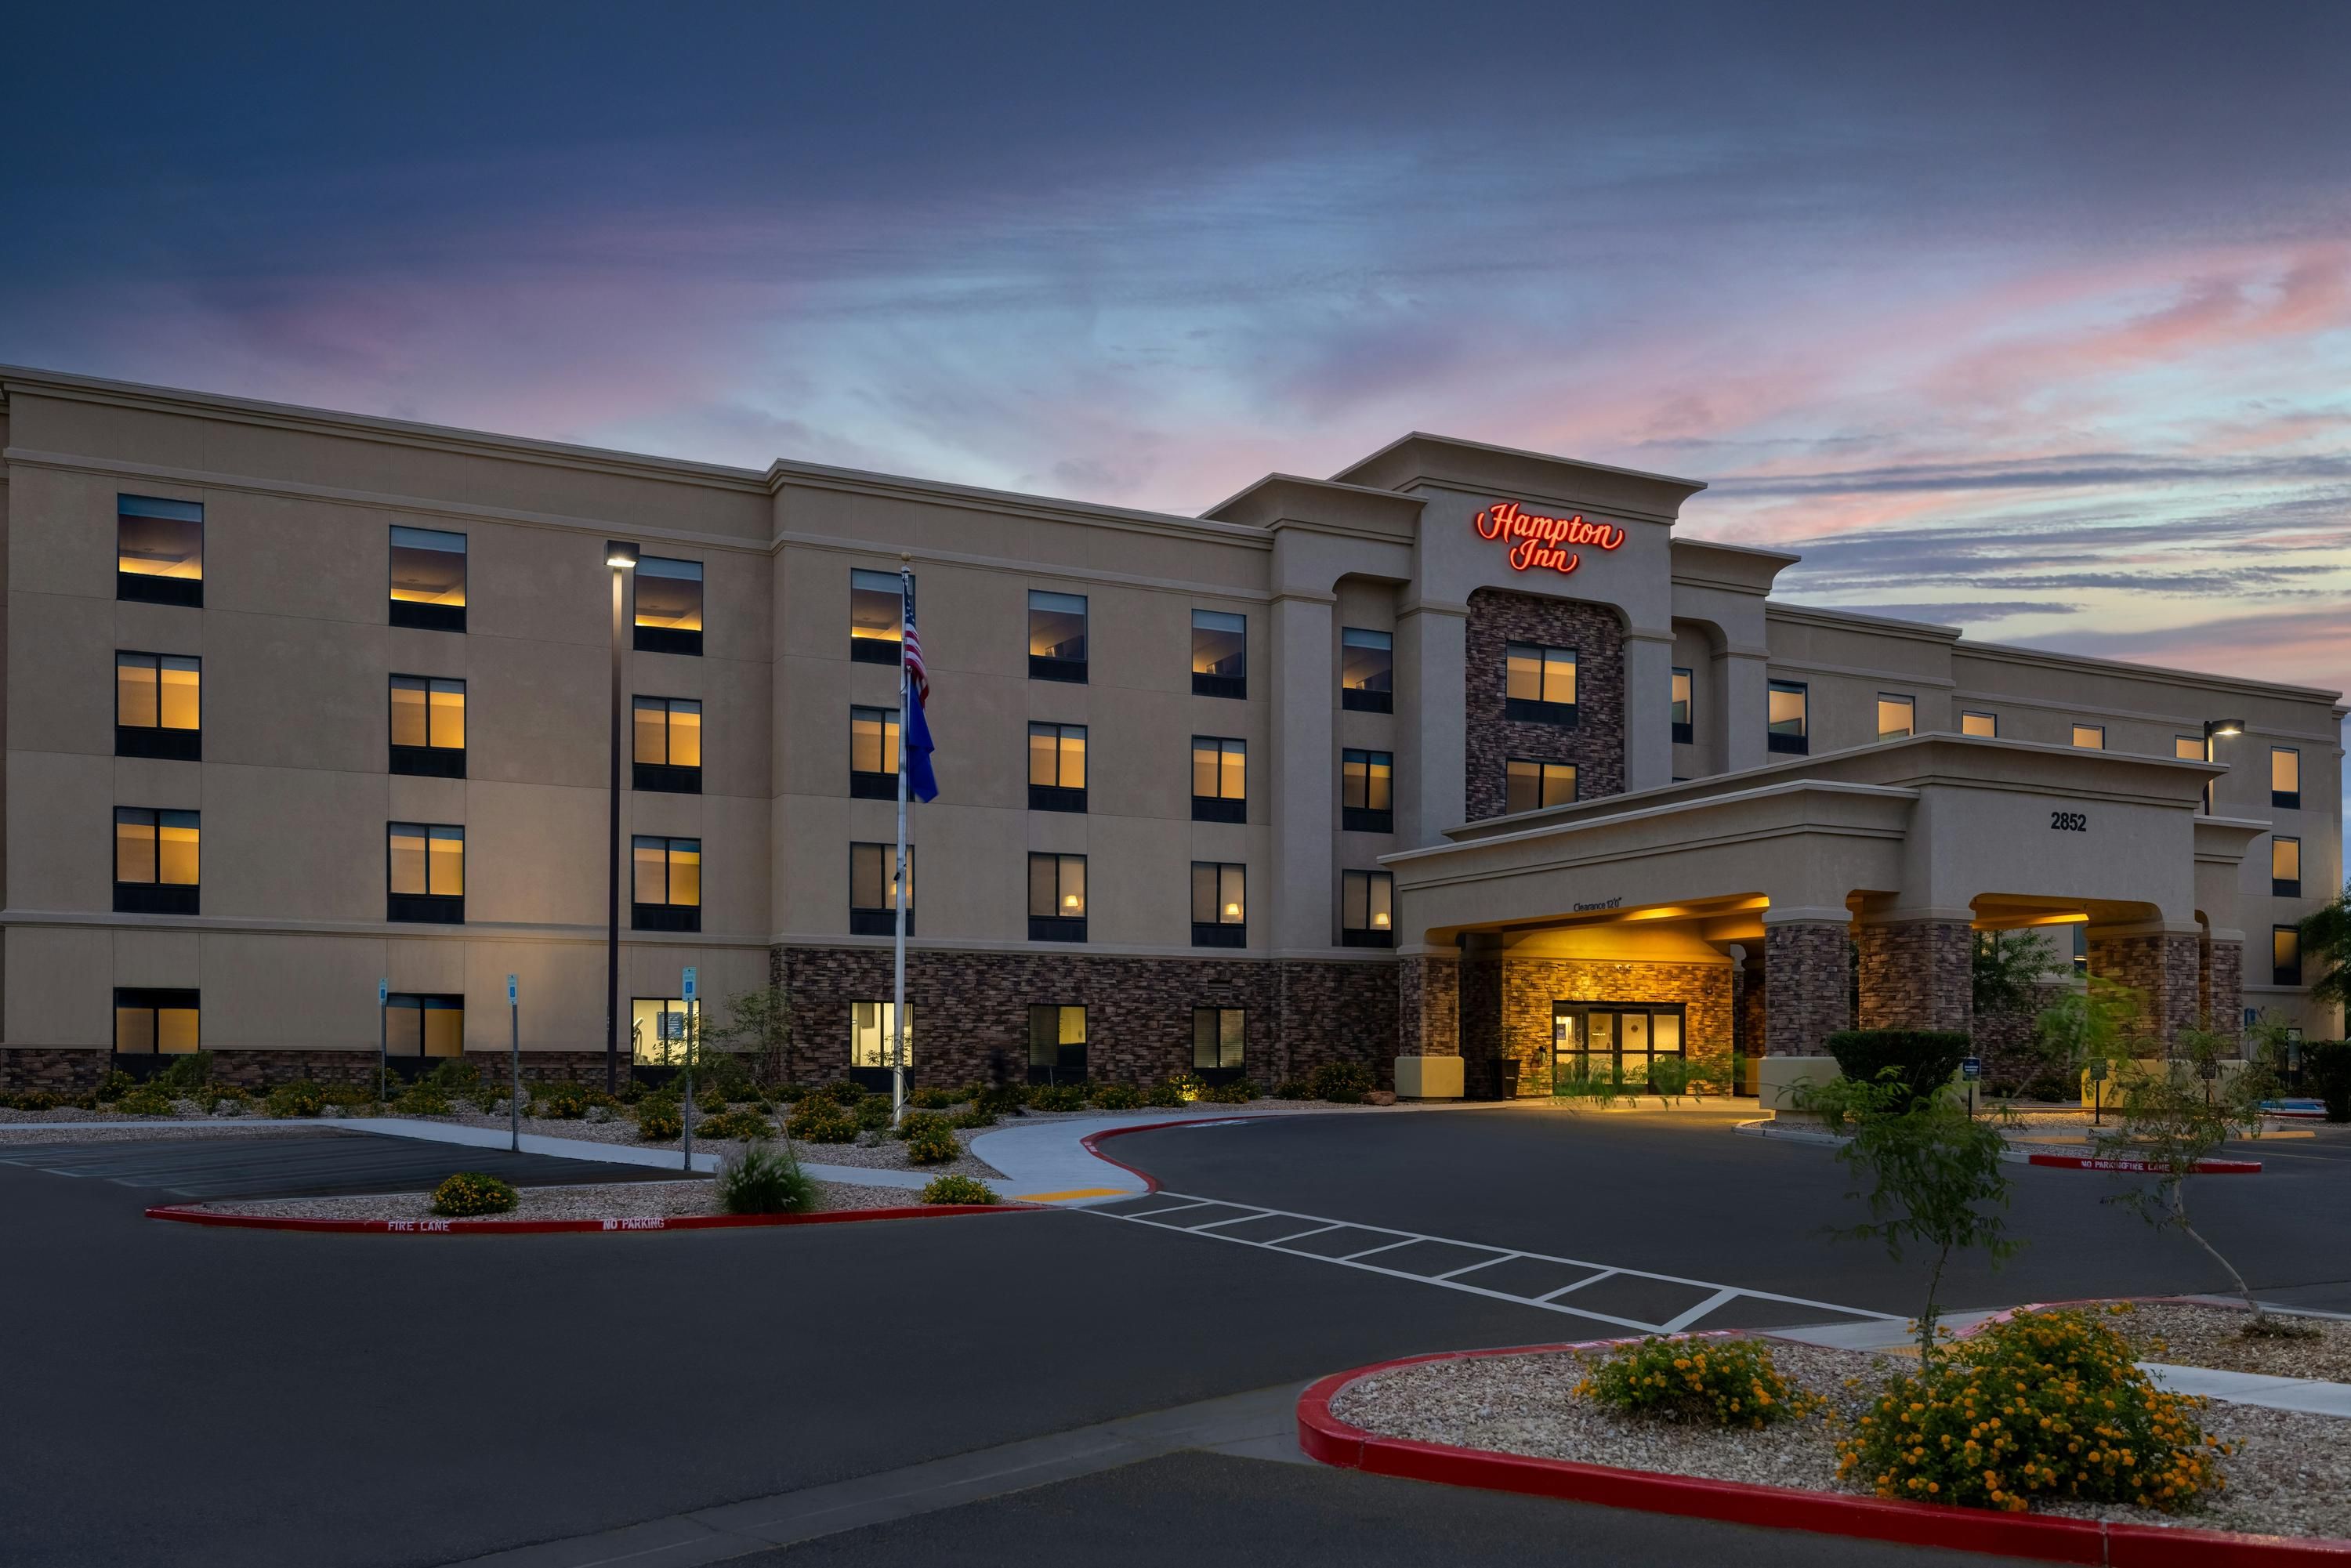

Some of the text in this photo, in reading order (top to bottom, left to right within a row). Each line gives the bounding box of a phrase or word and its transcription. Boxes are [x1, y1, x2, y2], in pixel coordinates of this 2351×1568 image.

[1475, 502, 1625, 549] Hampton
[1509, 538, 1579, 572] Inn
[2050, 811, 2087, 832] 2852
[1573, 903, 1606, 912] Clearance
[388, 1221, 451, 1232] FIRE LANE
[603, 1218, 665, 1230] NO PARKING
